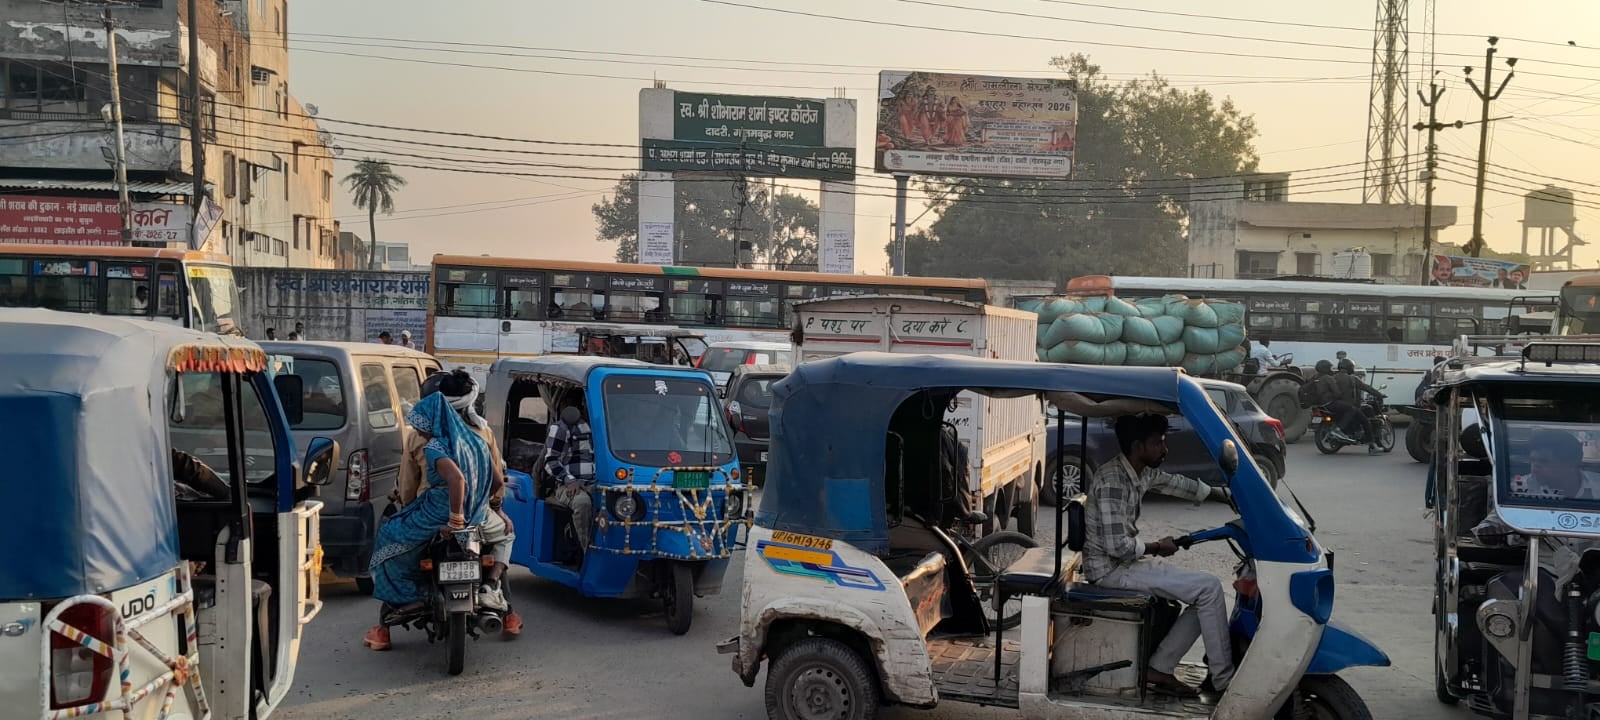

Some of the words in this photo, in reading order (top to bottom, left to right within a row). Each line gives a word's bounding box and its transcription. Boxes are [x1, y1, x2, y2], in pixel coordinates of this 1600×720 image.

[680, 102, 695, 118] स्व.
[697, 98, 709, 119] श्री
[711, 100, 746, 120] शोभाराम
[748, 101, 766, 121] शर्मा
[790, 104, 818, 124] कॉलेज
[1047, 102, 1071, 112] 2026
[773, 130, 794, 140] नगर
[8, 201, 26, 211] शराब
[28, 199, 38, 211] की
[40, 202, 60, 213] दुकान
[66, 201, 77, 213] नई
[78, 201, 103, 213] आबादी
[820, 318, 847, 334] पशु
[849, 319, 873, 333] पर
[902, 319, 929, 334] दया
[1407, 349, 1424, 358] उत्तर
[452, 591, 469, 600] VIP
